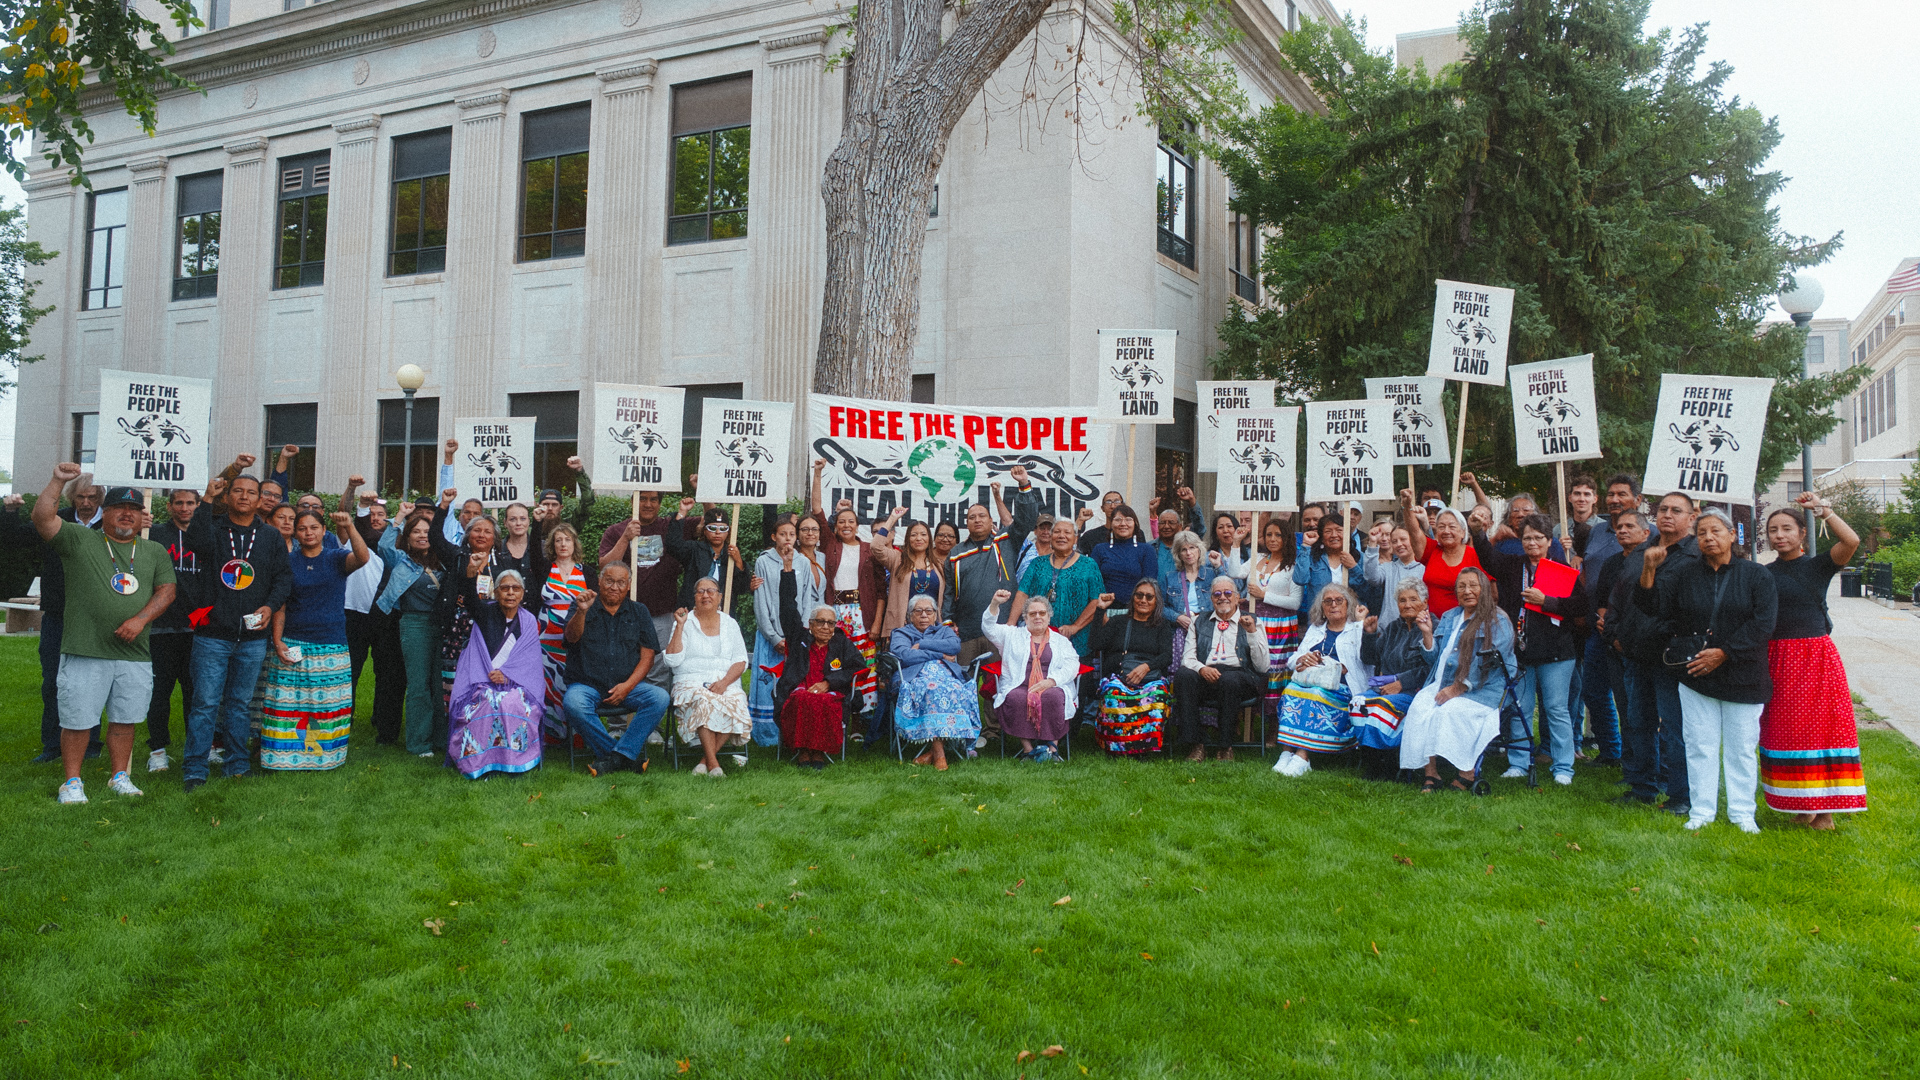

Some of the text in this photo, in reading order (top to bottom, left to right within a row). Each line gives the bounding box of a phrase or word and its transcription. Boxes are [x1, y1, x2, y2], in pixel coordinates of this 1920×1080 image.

[1454, 290, 1488, 303] FREE THE
[1453, 301, 1489, 317] PEOPLE
[1117, 337, 1152, 346] FREE THE
[1116, 348, 1154, 360] PEOPLE
[1453, 347, 1486, 358] HEAL THE
[1454, 357, 1488, 375] LAND
[1528, 369, 1565, 383] FREE THE
[129, 383, 178, 399] FREE THE
[1213, 387, 1247, 396] FREE THE
[1384, 384, 1418, 394] FREE THE
[1529, 380, 1568, 396] PEOPLE
[1684, 387, 1733, 400] FREE THE
[1120, 391, 1154, 400] HEAL THE
[128, 396, 180, 414] PEOPLE
[617, 397, 656, 409] FREE THE
[1122, 400, 1158, 415] LAND
[1214, 398, 1250, 409] PEOPLE
[1681, 400, 1733, 418] PEOPLE
[616, 408, 658, 424] PEOPLE
[724, 410, 763, 422] FREE THE
[1327, 409, 1367, 420] FREE THE
[473, 425, 509, 435] FREE THE
[723, 421, 764, 436] PEOPLE
[829, 406, 1088, 452] FREE THE PEOPLE
[1237, 418, 1273, 429] FREE THE
[1327, 420, 1367, 434] PEOPLE
[1237, 429, 1276, 442] PEOPLE
[1393, 434, 1427, 443] HEAL THE
[1538, 427, 1574, 438] HEAL THE
[474, 435, 511, 447] PEOPLE
[1541, 436, 1579, 455] LAND
[131, 449, 180, 462] HEAL THE
[1396, 443, 1431, 457] LAND
[619, 455, 657, 466] HEAL THE
[1678, 457, 1724, 472] HEAL THE
[134, 461, 184, 481] LAND
[622, 466, 662, 483] LAND
[725, 469, 762, 480] HEAL THE
[1331, 468, 1369, 478] HEAL THE
[479, 477, 513, 486] HEAL THE
[1240, 475, 1276, 484] HEAL THE
[1677, 470, 1728, 493] LAND
[727, 480, 767, 497] LAND
[1243, 484, 1279, 501] LAND
[1334, 478, 1373, 495] LAND
[482, 486, 517, 501] LAND
[831, 488, 917, 526] HEAL
[924, 497, 969, 529] THE
